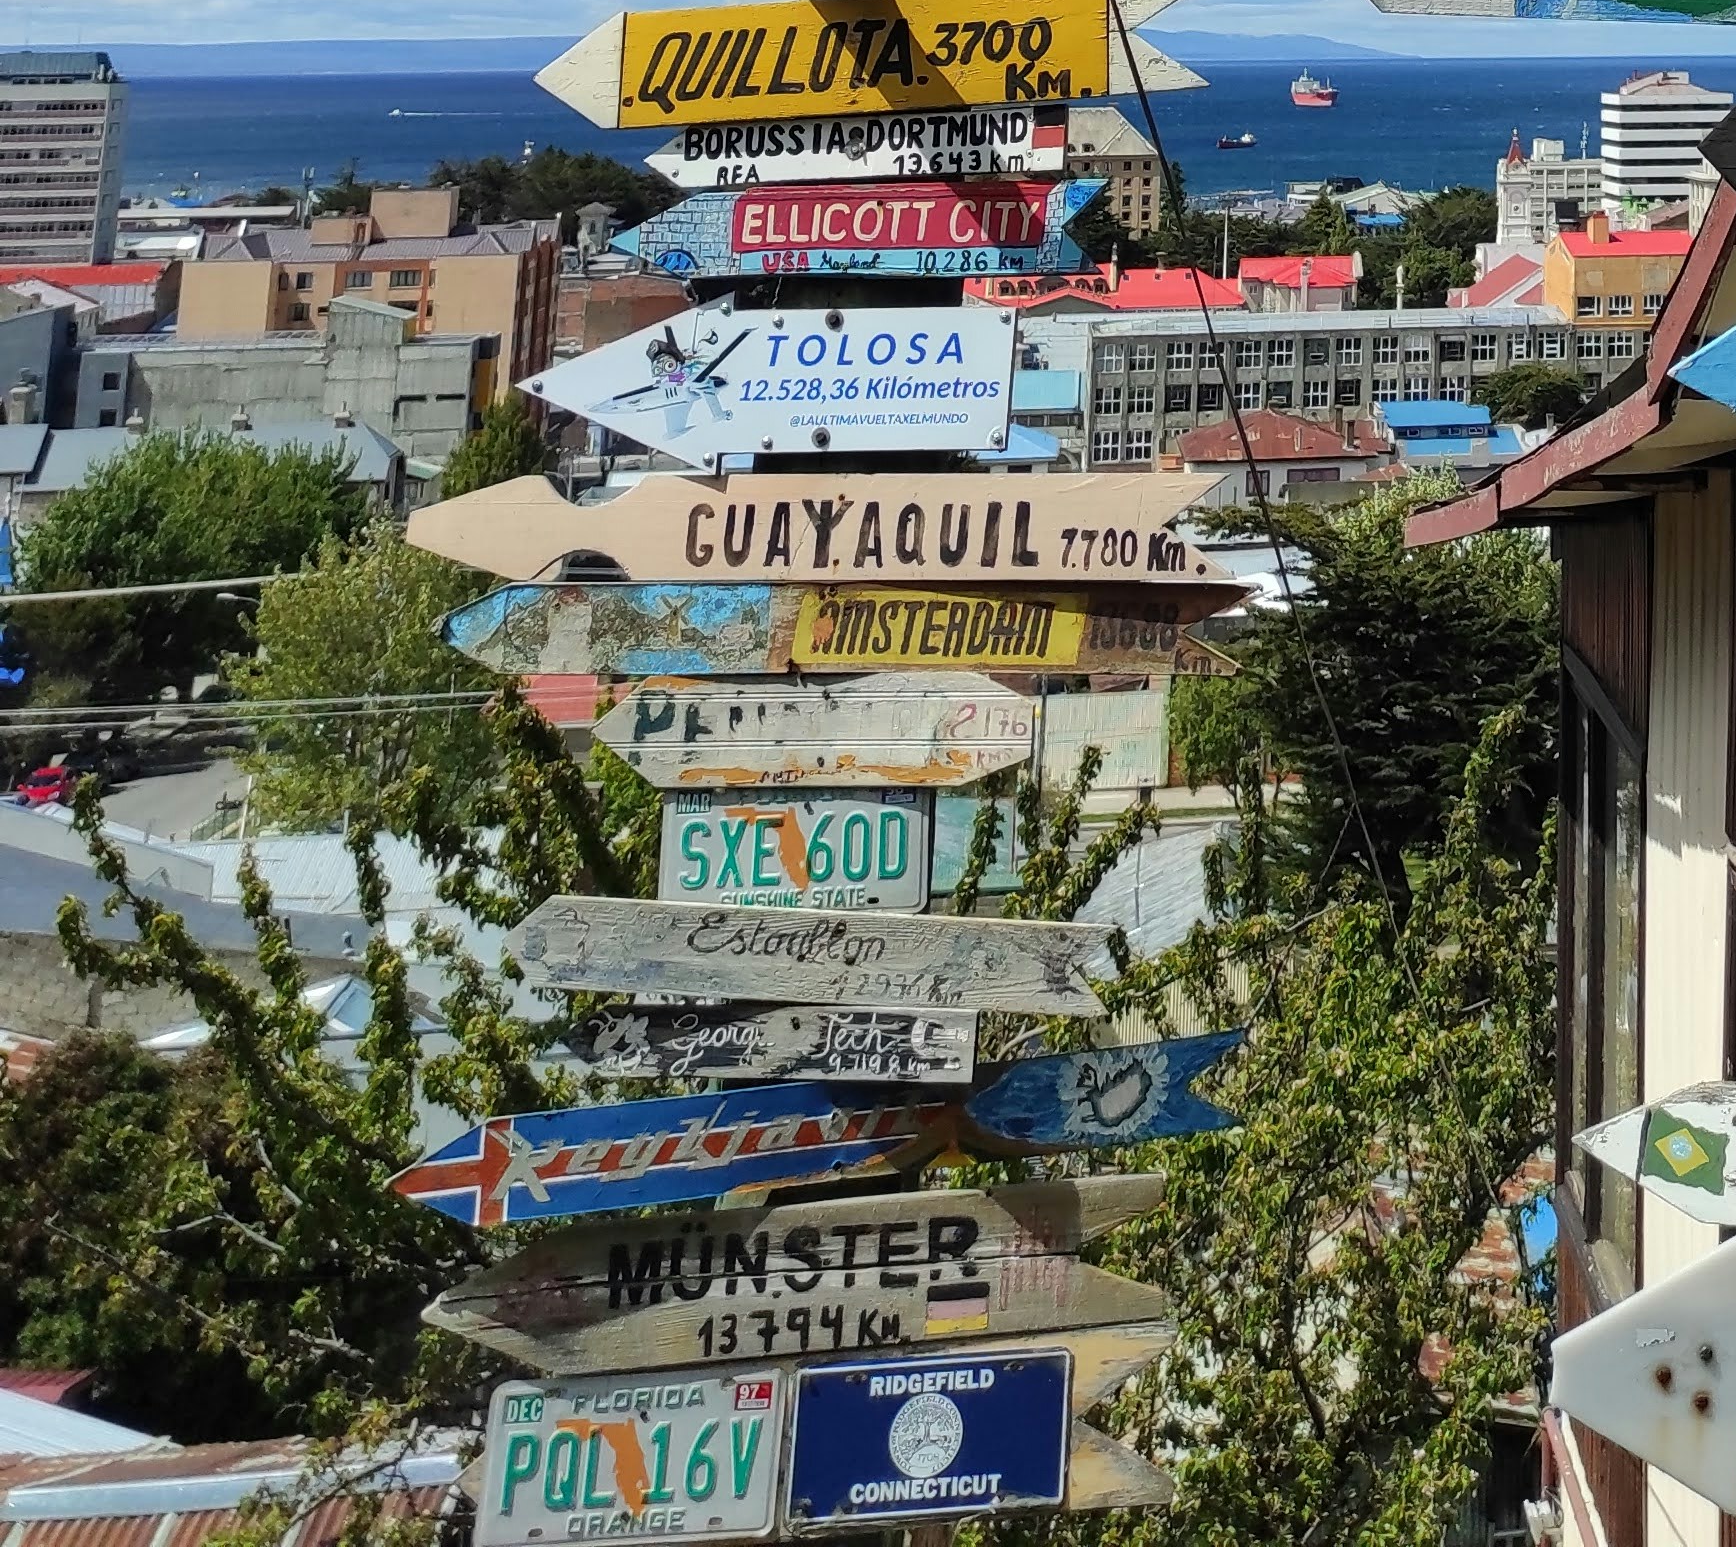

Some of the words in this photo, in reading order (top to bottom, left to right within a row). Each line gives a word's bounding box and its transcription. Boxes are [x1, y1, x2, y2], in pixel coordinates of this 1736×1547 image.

[926, 16, 1053, 67] 3700
[683, 120, 845, 161] BORUSSIA
[866, 113, 1029, 152] DORTMUND
[892, 150, 983, 176] 13.643
[740, 203, 939, 245] ELLICOTT
[948, 201, 1040, 243] CITY
[761, 251, 810, 274] USA
[766, 332, 965, 368] TOLOSA
[739, 377, 860, 404] 12.528,36
[866, 376, 1001, 400] Kilómetros
[686, 499, 1041, 571] GUAYAQUIL
[809, 597, 1056, 659] AMSTERDAM
[680, 816, 782, 891] SXE
[807, 810, 909, 884] 60D
[811, 887, 866, 907] STATE
[607, 1215, 979, 1308] MÜNSTER
[698, 1305, 844, 1357] 13794
[572, 1383, 706, 1414] FLORIDA
[738, 1382, 761, 1401] 97
[868, 1369, 996, 1397] RIDGEFIELD
[506, 1395, 544, 1423] DEC
[500, 1422, 617, 1515] PQL
[646, 1417, 764, 1504] 16V
[848, 1473, 1002, 1505] CONNECTICUT
[566, 1509, 686, 1537] ORANGE
